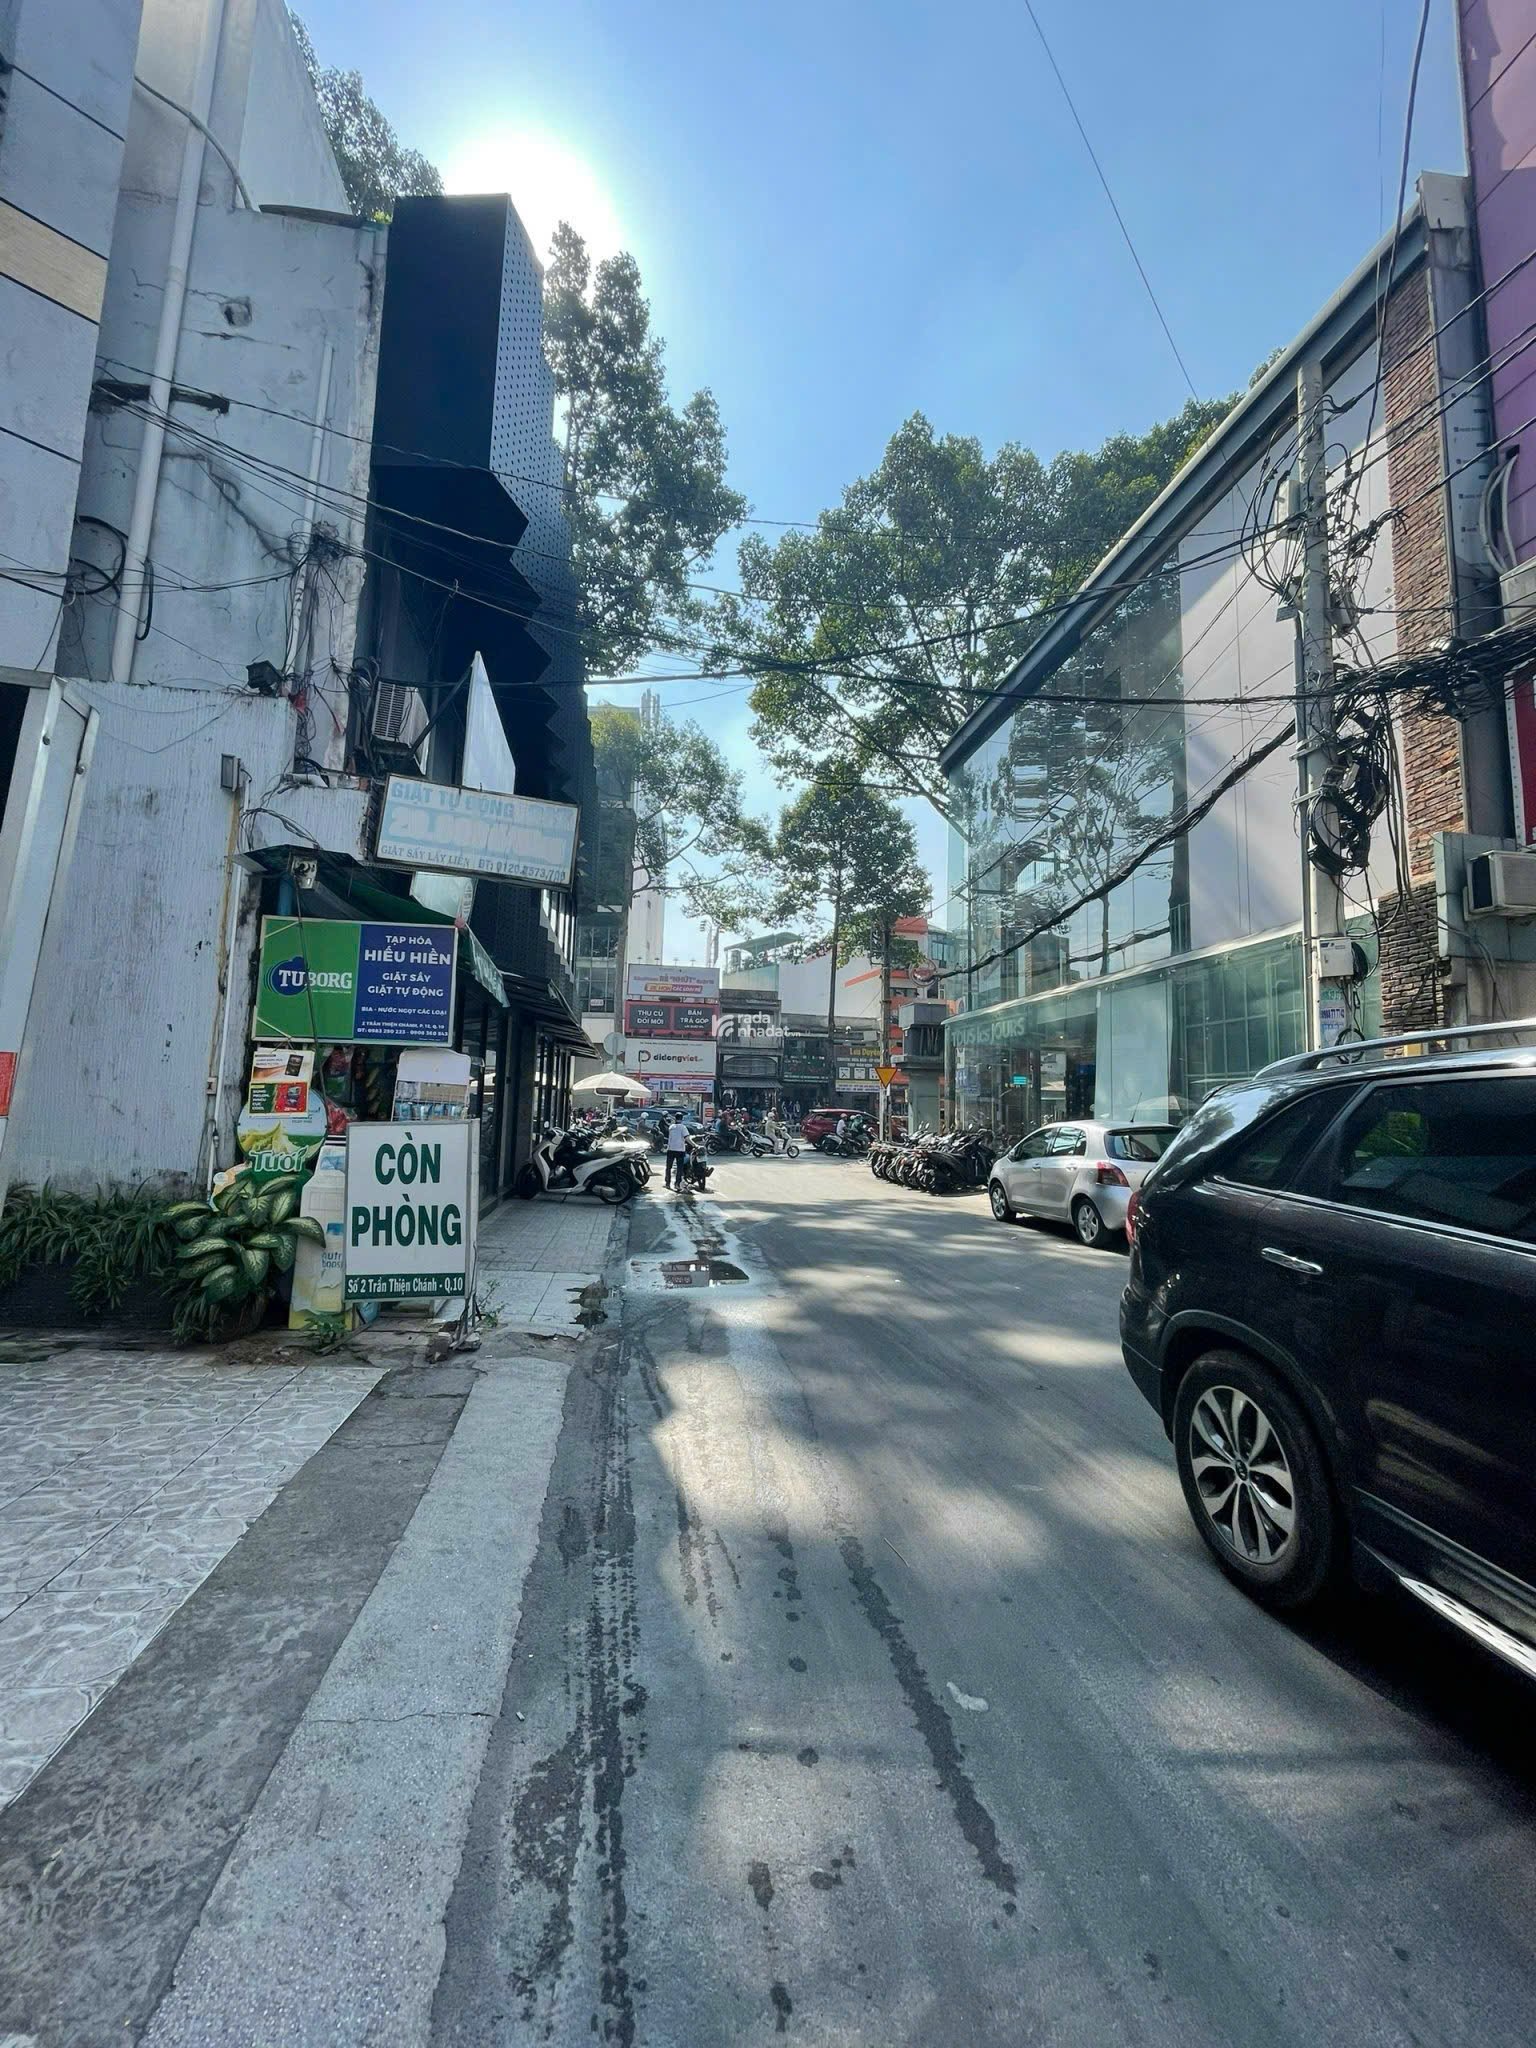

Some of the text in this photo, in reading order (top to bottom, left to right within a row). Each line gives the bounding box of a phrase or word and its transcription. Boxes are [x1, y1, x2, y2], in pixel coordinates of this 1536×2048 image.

[385, 935, 433, 946] TẠP HÓA
[364, 945, 452, 965] HIẾU HIỀN
[278, 969, 353, 989] TUBORG
[382, 971, 408, 984] GIẶT
[367, 984, 444, 999] GIẶT TỰ ĐỘNG
[398, 1007, 417, 1015] NGỌT
[249, 1144, 309, 1173] Tươi
[375, 1132, 442, 1185] CÒN
[351, 1193, 462, 1247] PHÒNG
[347, 1277, 360, 1293] Số
[360, 1279, 366, 1293] 2
[368, 1276, 387, 1293] Trần
[389, 1278, 411, 1295] Thiện
[412, 1277, 437, 1292] Chánh
[444, 1277, 464, 1294] Q.10
